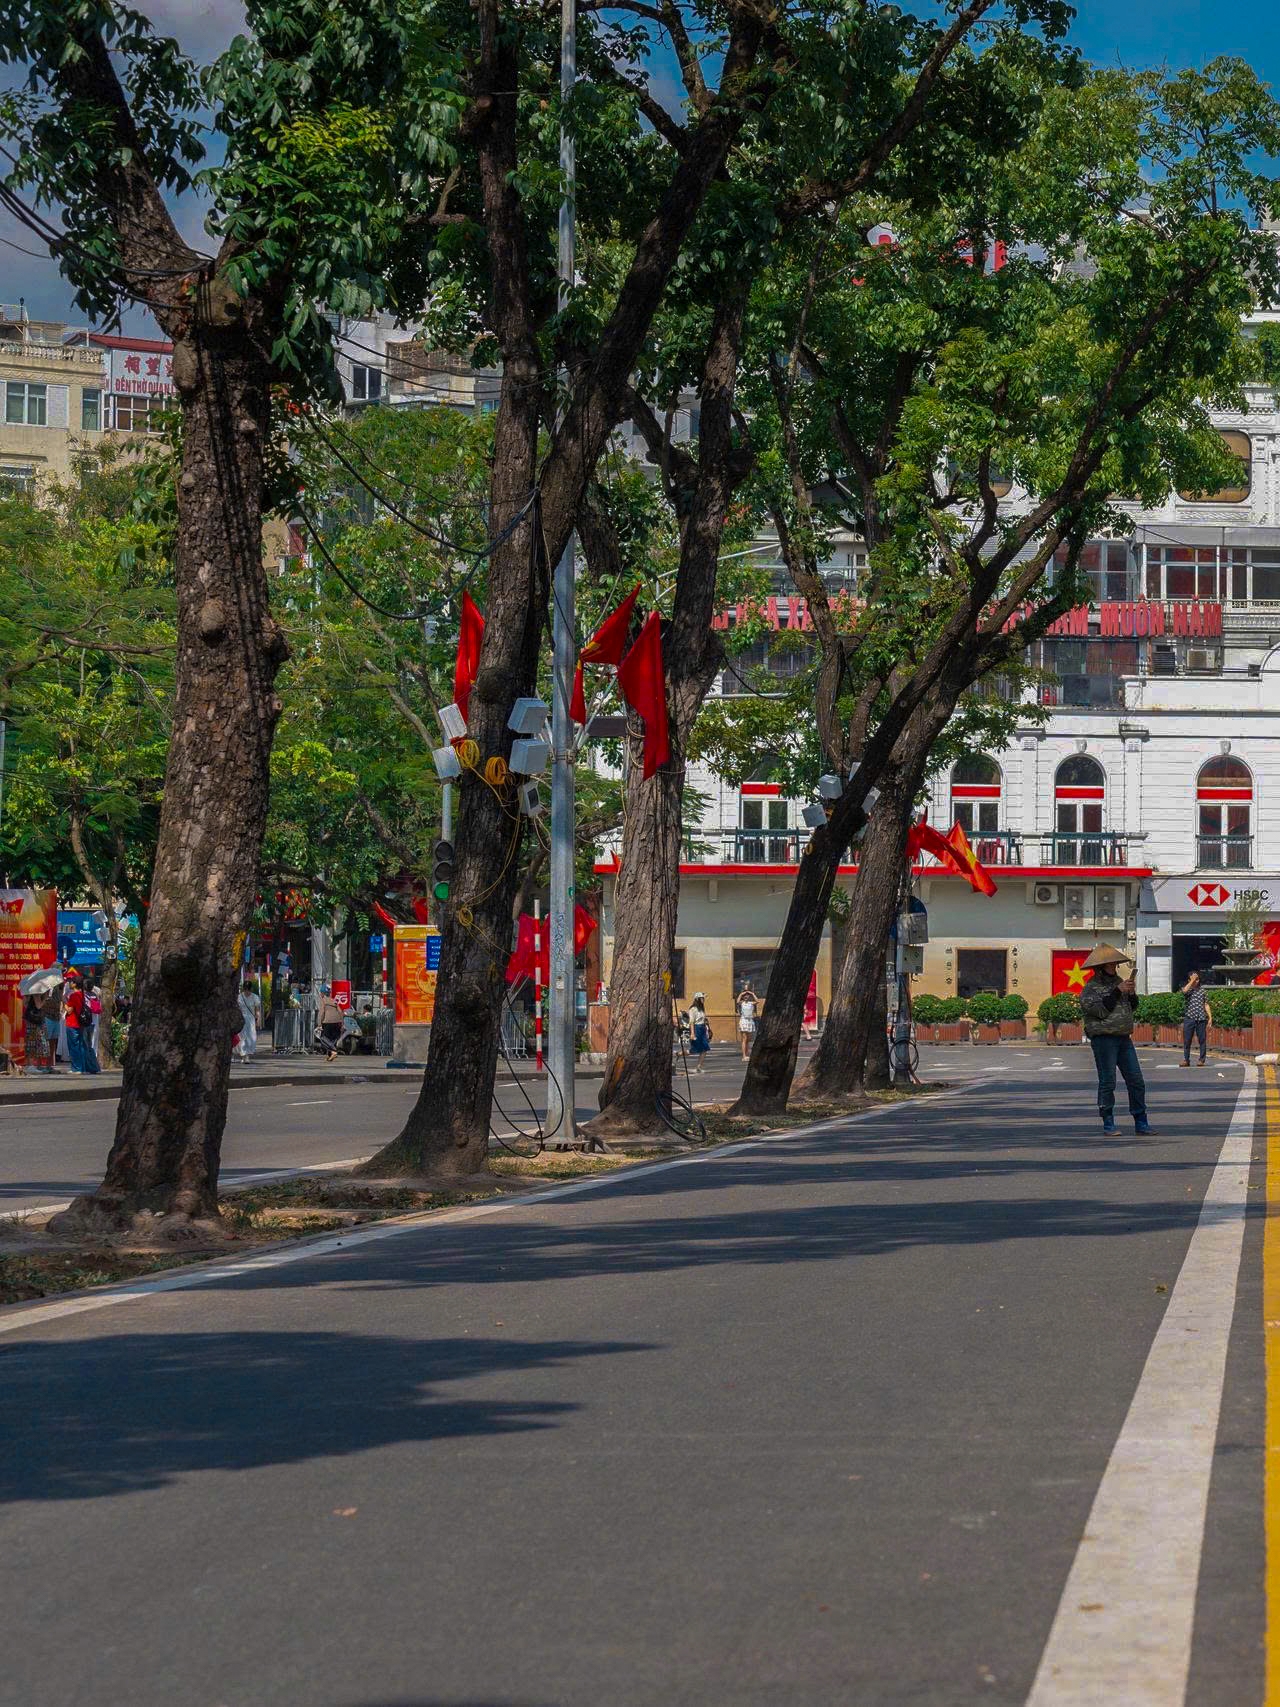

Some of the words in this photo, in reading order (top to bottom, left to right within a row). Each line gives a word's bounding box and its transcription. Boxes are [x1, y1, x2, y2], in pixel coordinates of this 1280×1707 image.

[1101, 593, 1165, 637] MUÔN
[1173, 594, 1222, 637] NĂM
[1233, 889, 1269, 901] HSBC
